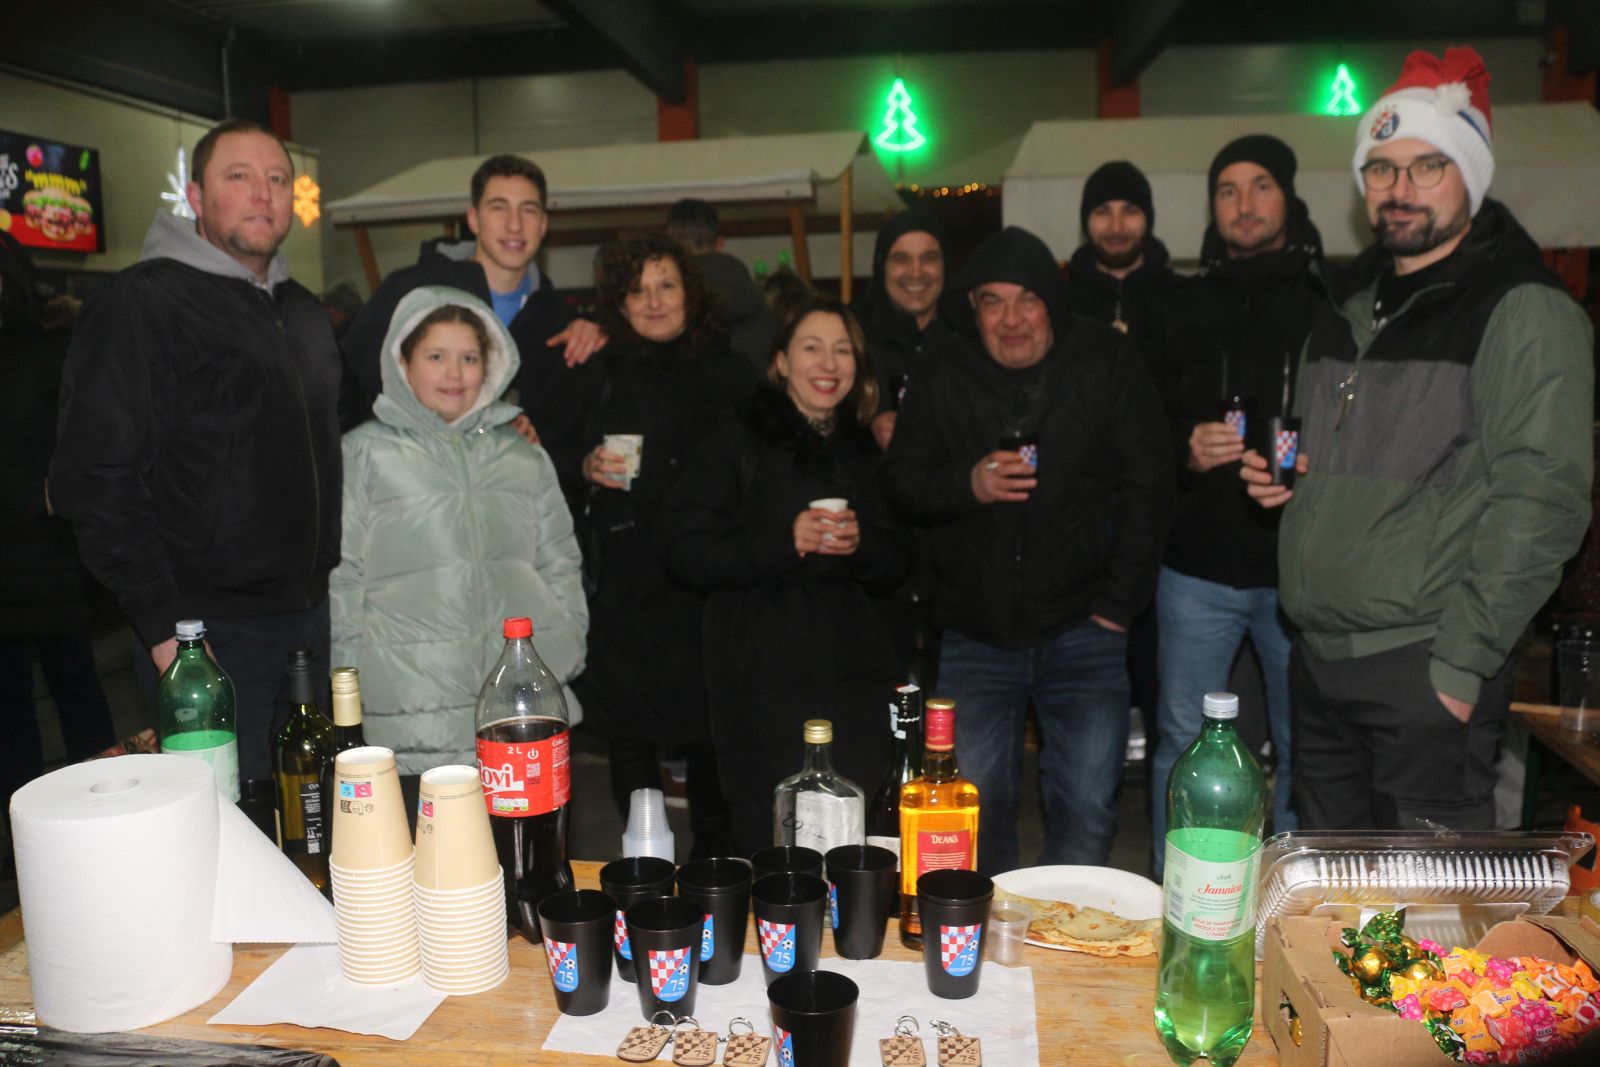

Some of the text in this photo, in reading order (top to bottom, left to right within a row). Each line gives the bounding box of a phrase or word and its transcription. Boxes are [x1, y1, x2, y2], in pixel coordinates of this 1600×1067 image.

[507, 746, 523, 754] 2 L
[775, 951, 791, 964] 75
[960, 953, 974, 966] 75
[559, 971, 574, 984] 75
[670, 977, 685, 992] 75
[639, 1045, 653, 1054] 75
[695, 1050, 710, 1058] 75
[746, 1054, 761, 1062] 75
